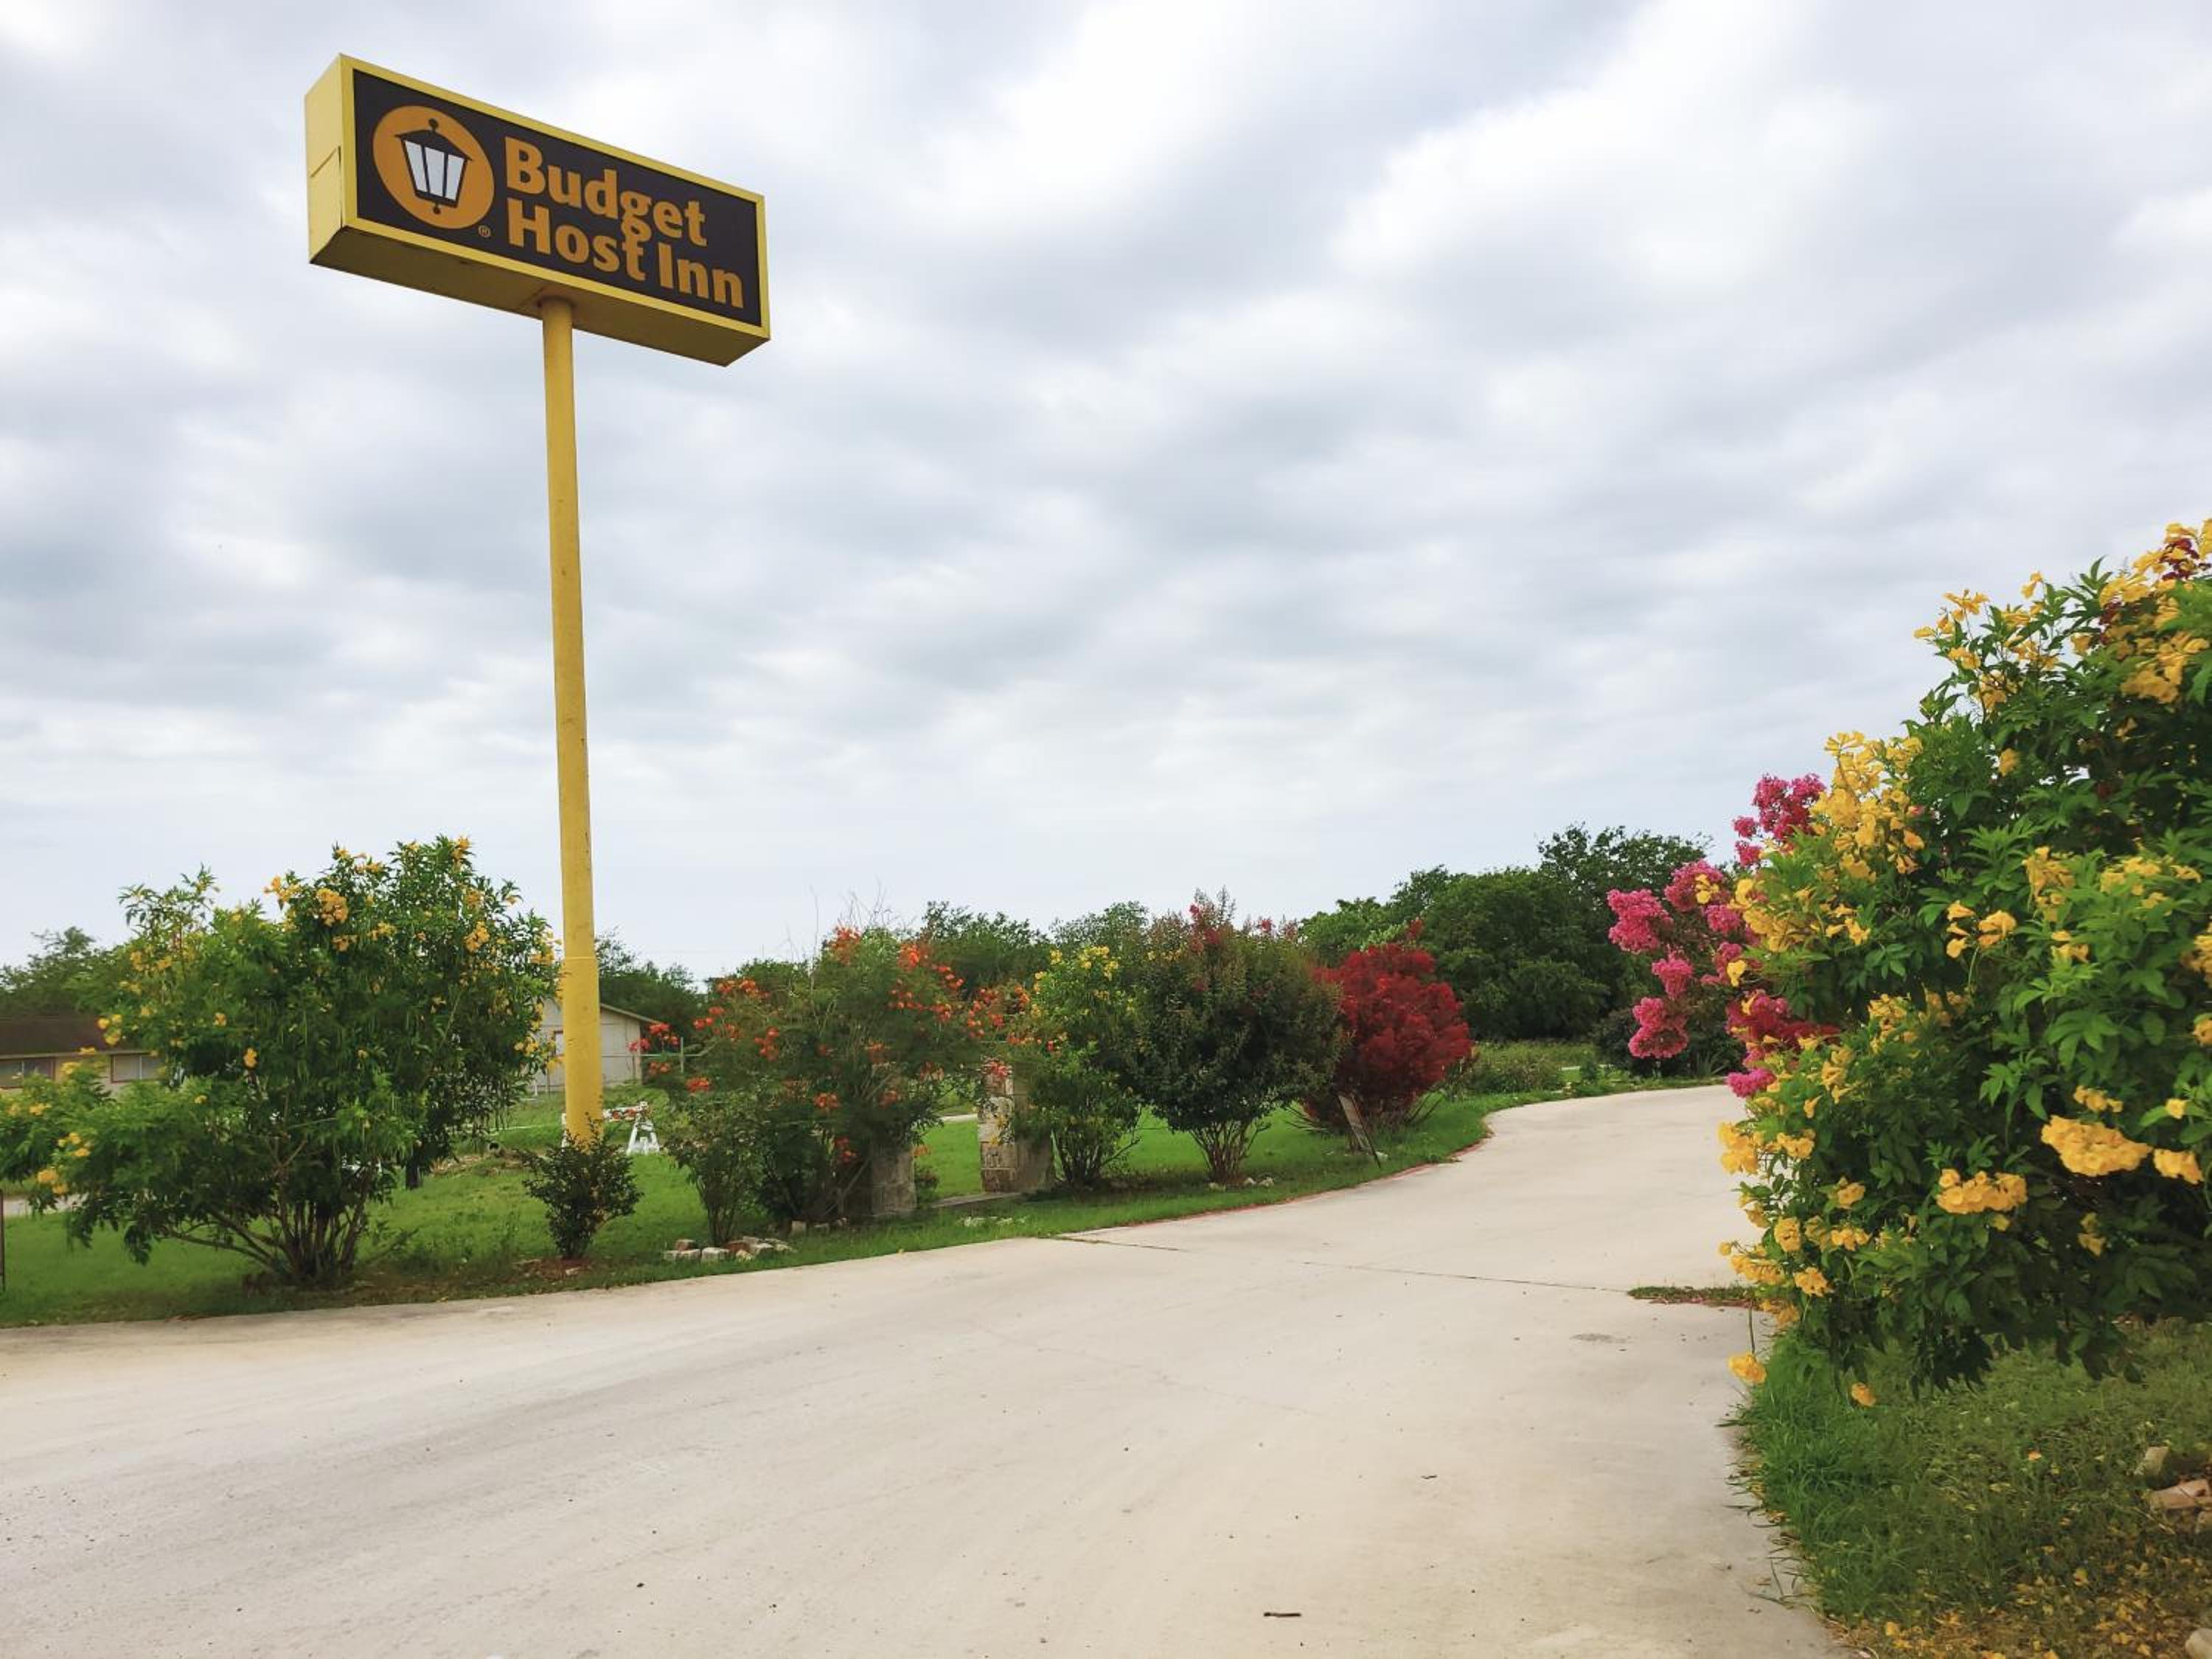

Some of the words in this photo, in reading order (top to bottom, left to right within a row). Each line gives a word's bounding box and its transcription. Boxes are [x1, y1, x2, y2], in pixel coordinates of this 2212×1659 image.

[504, 136, 707, 246] Budget
[507, 198, 647, 281] Host
[657, 243, 745, 308] Inn
